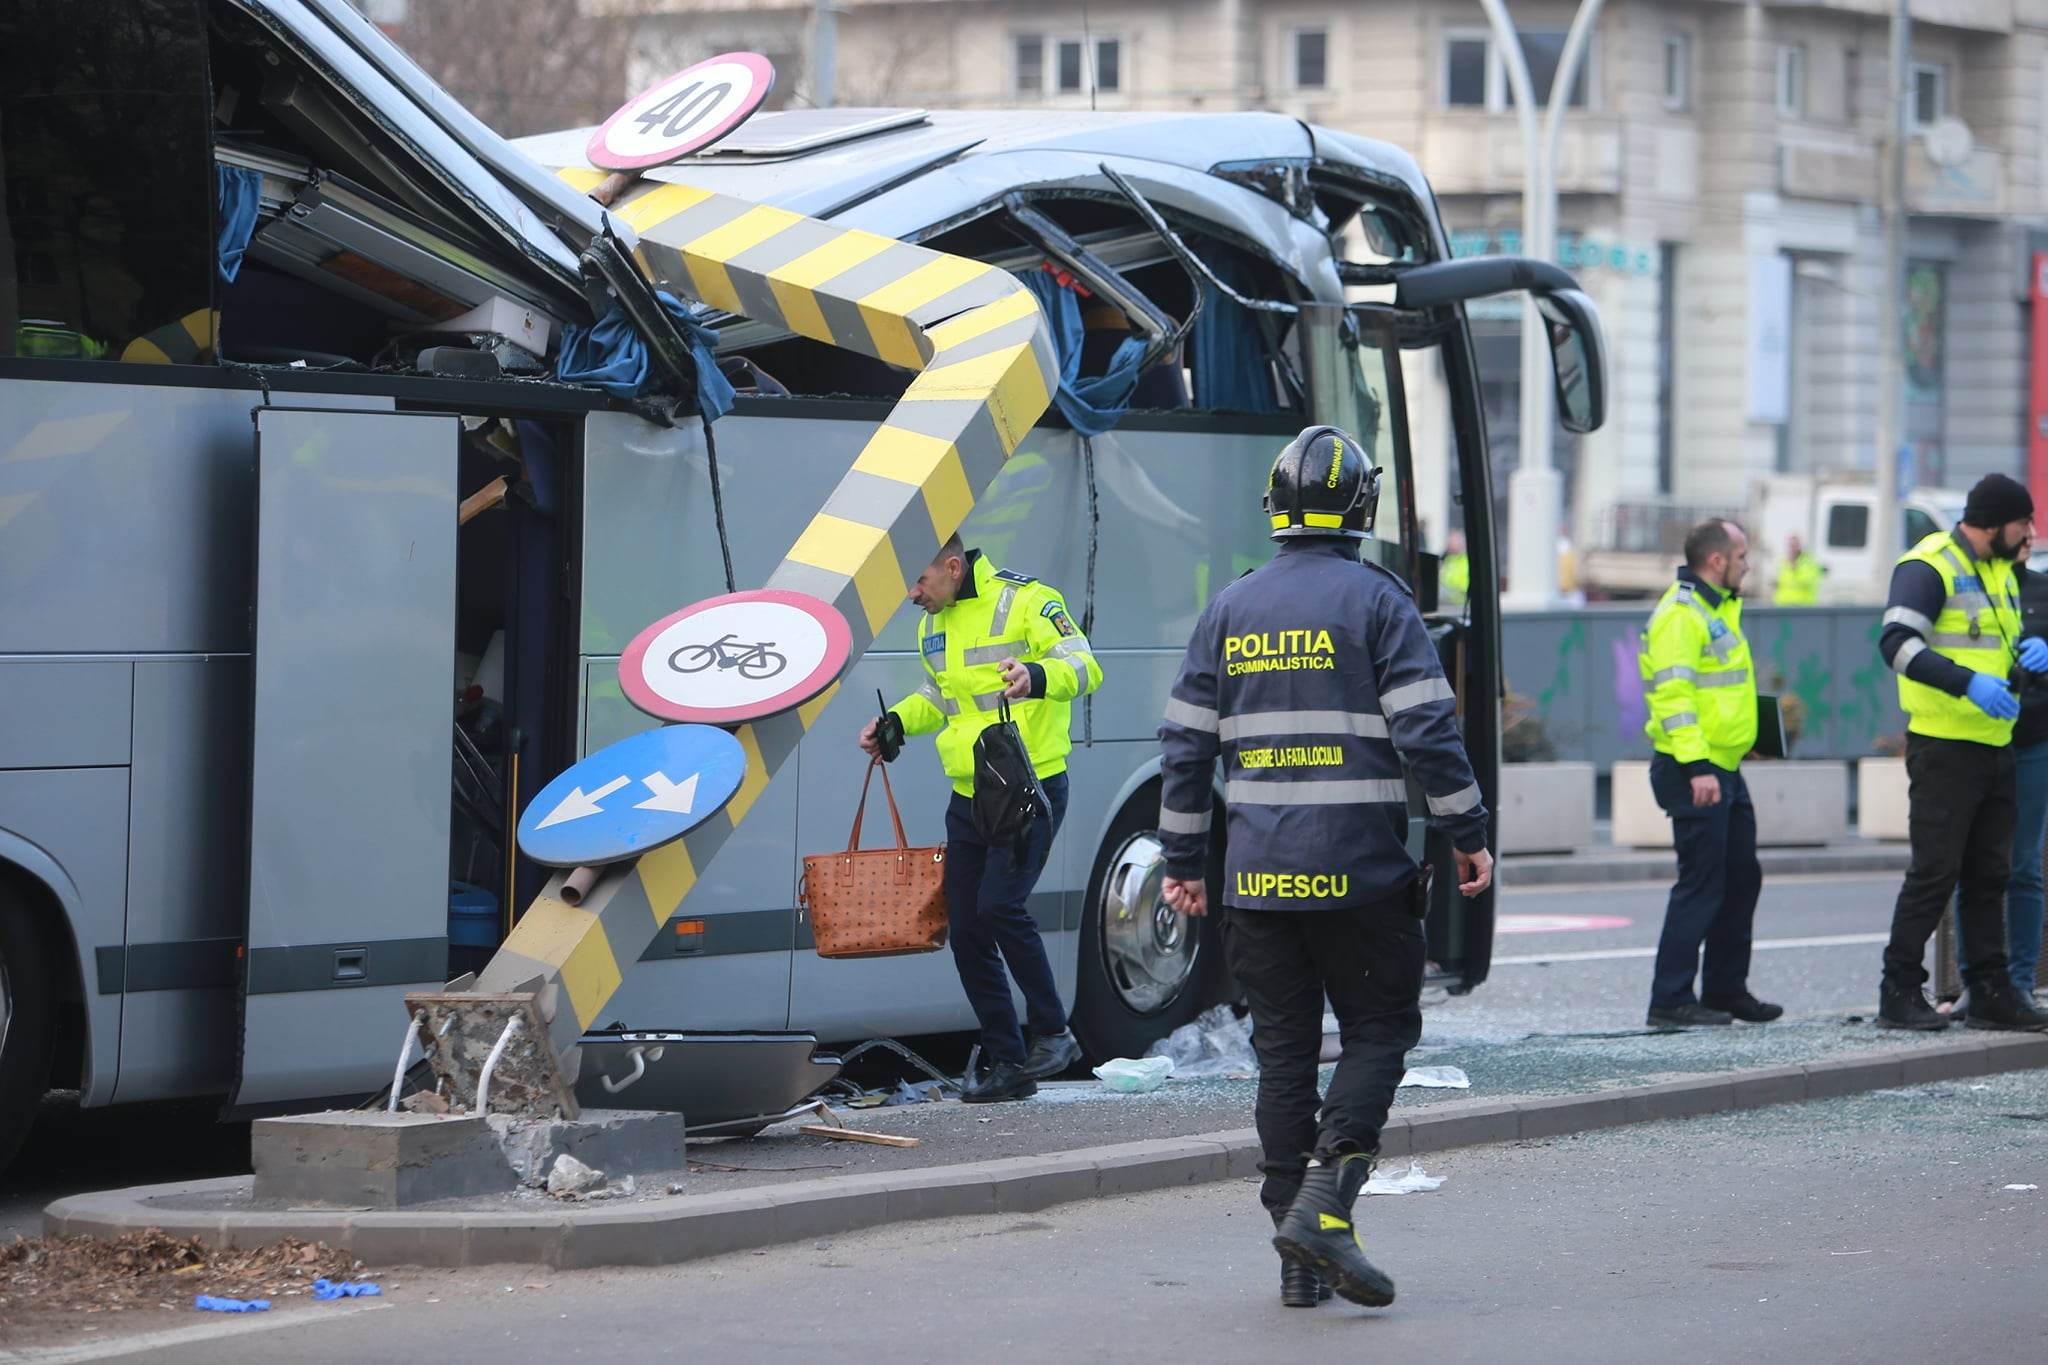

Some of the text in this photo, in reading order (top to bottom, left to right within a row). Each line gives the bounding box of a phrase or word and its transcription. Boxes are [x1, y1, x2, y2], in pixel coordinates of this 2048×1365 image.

[633, 81, 732, 138] 40
[1225, 630, 1335, 661] POLITIA
[1227, 656, 1334, 676] CRIMINALISTICA
[1274, 748, 1286, 767] LA
[1286, 747, 1307, 766] FATA
[1307, 746, 1343, 765] LOCULUI
[1237, 872, 1348, 898] LUPESCU
